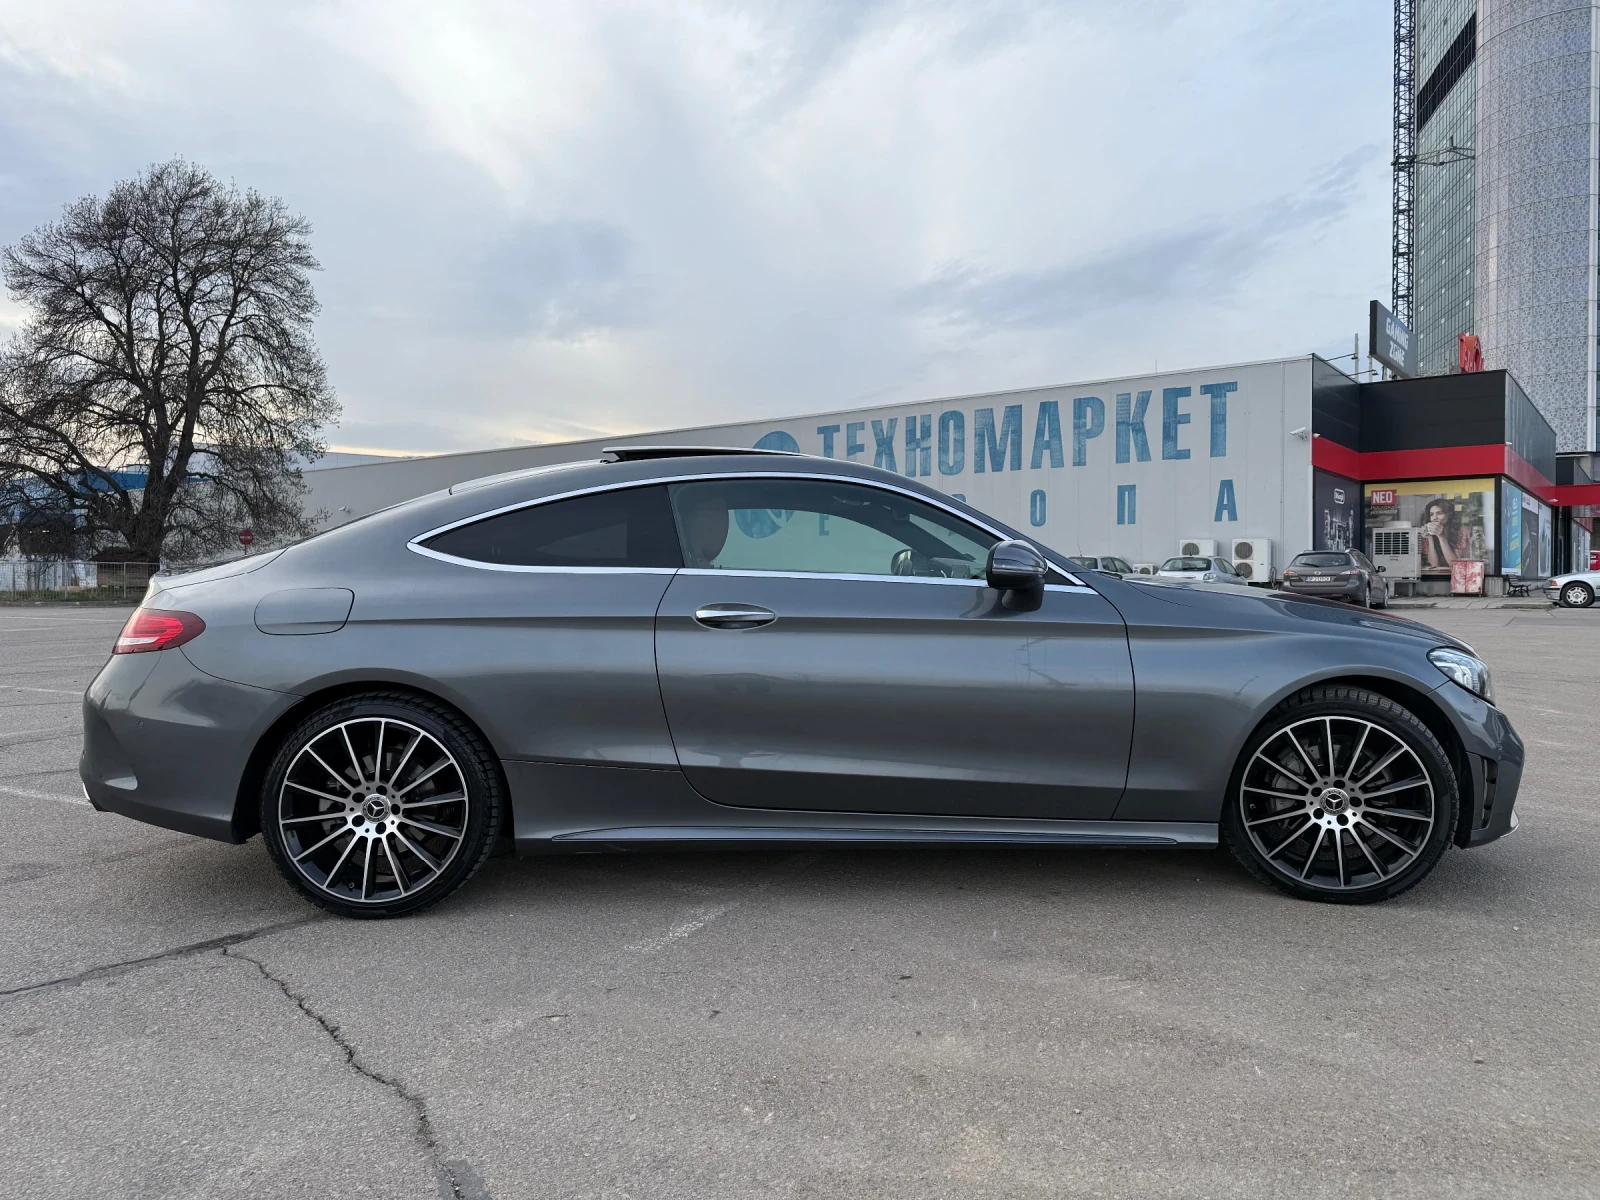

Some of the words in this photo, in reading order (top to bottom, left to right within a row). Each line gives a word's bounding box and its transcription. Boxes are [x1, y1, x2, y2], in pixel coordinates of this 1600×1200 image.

[1385, 317, 1409, 351] GAMING
[816, 381, 1239, 478] ТЕХНОМАРКЕТ
[1372, 491, 1393, 504] NEO
